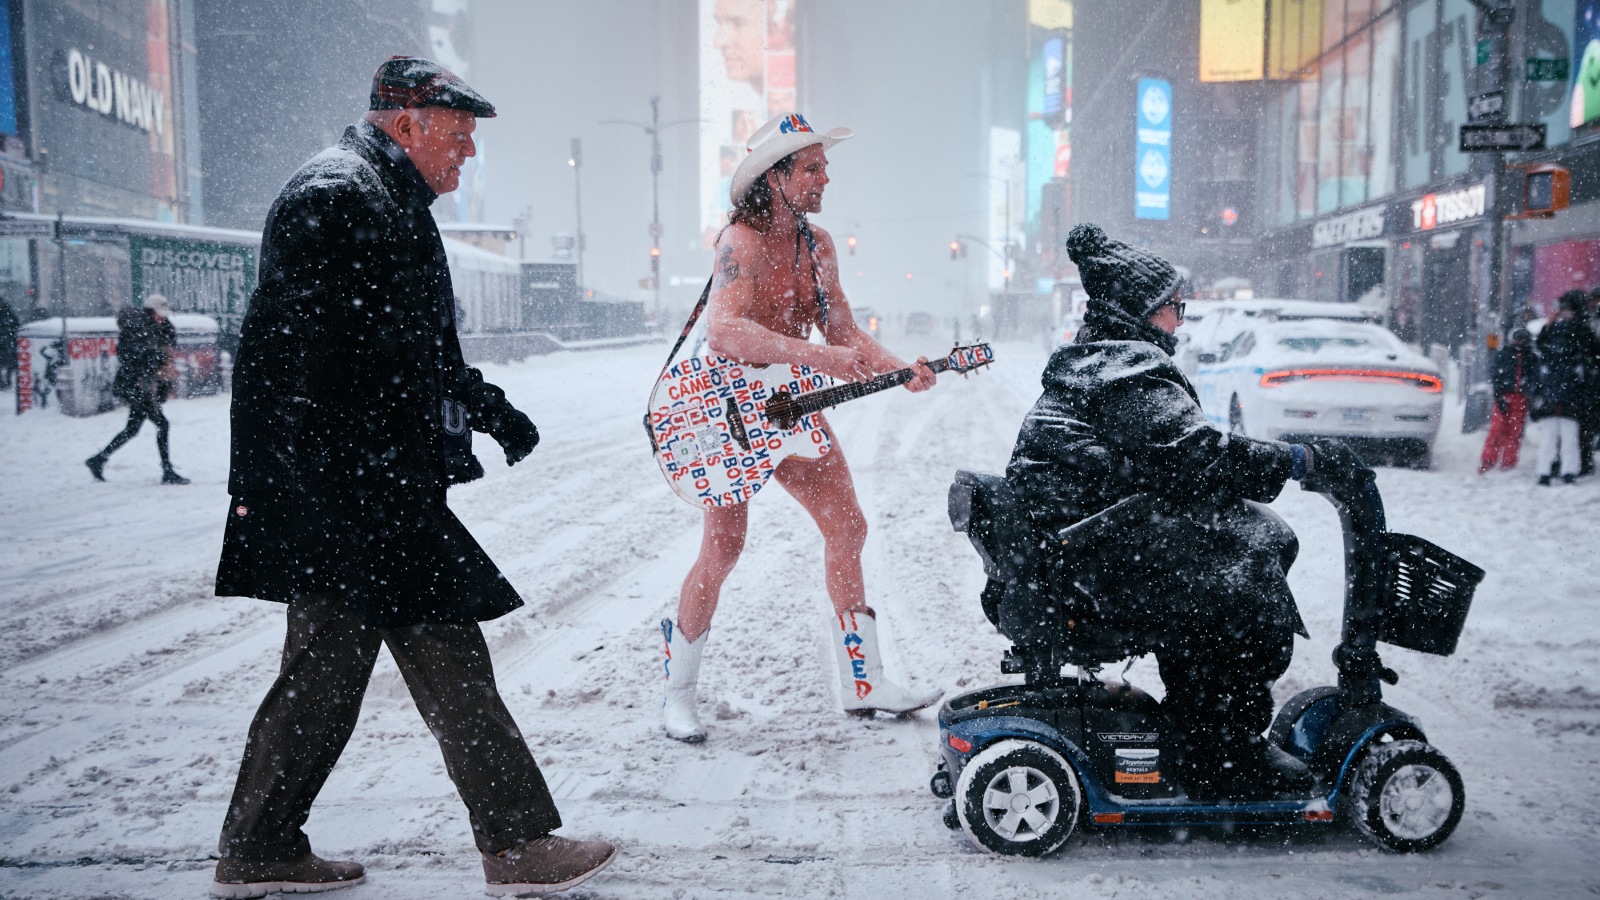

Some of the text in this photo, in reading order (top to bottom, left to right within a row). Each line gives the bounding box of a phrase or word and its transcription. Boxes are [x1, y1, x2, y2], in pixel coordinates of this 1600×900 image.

[68, 48, 164, 136] OLD NAVY
[1436, 184, 1486, 225] TISSOT
[142, 247, 245, 272] DISCOVER
[948, 346, 994, 369] NAKED
